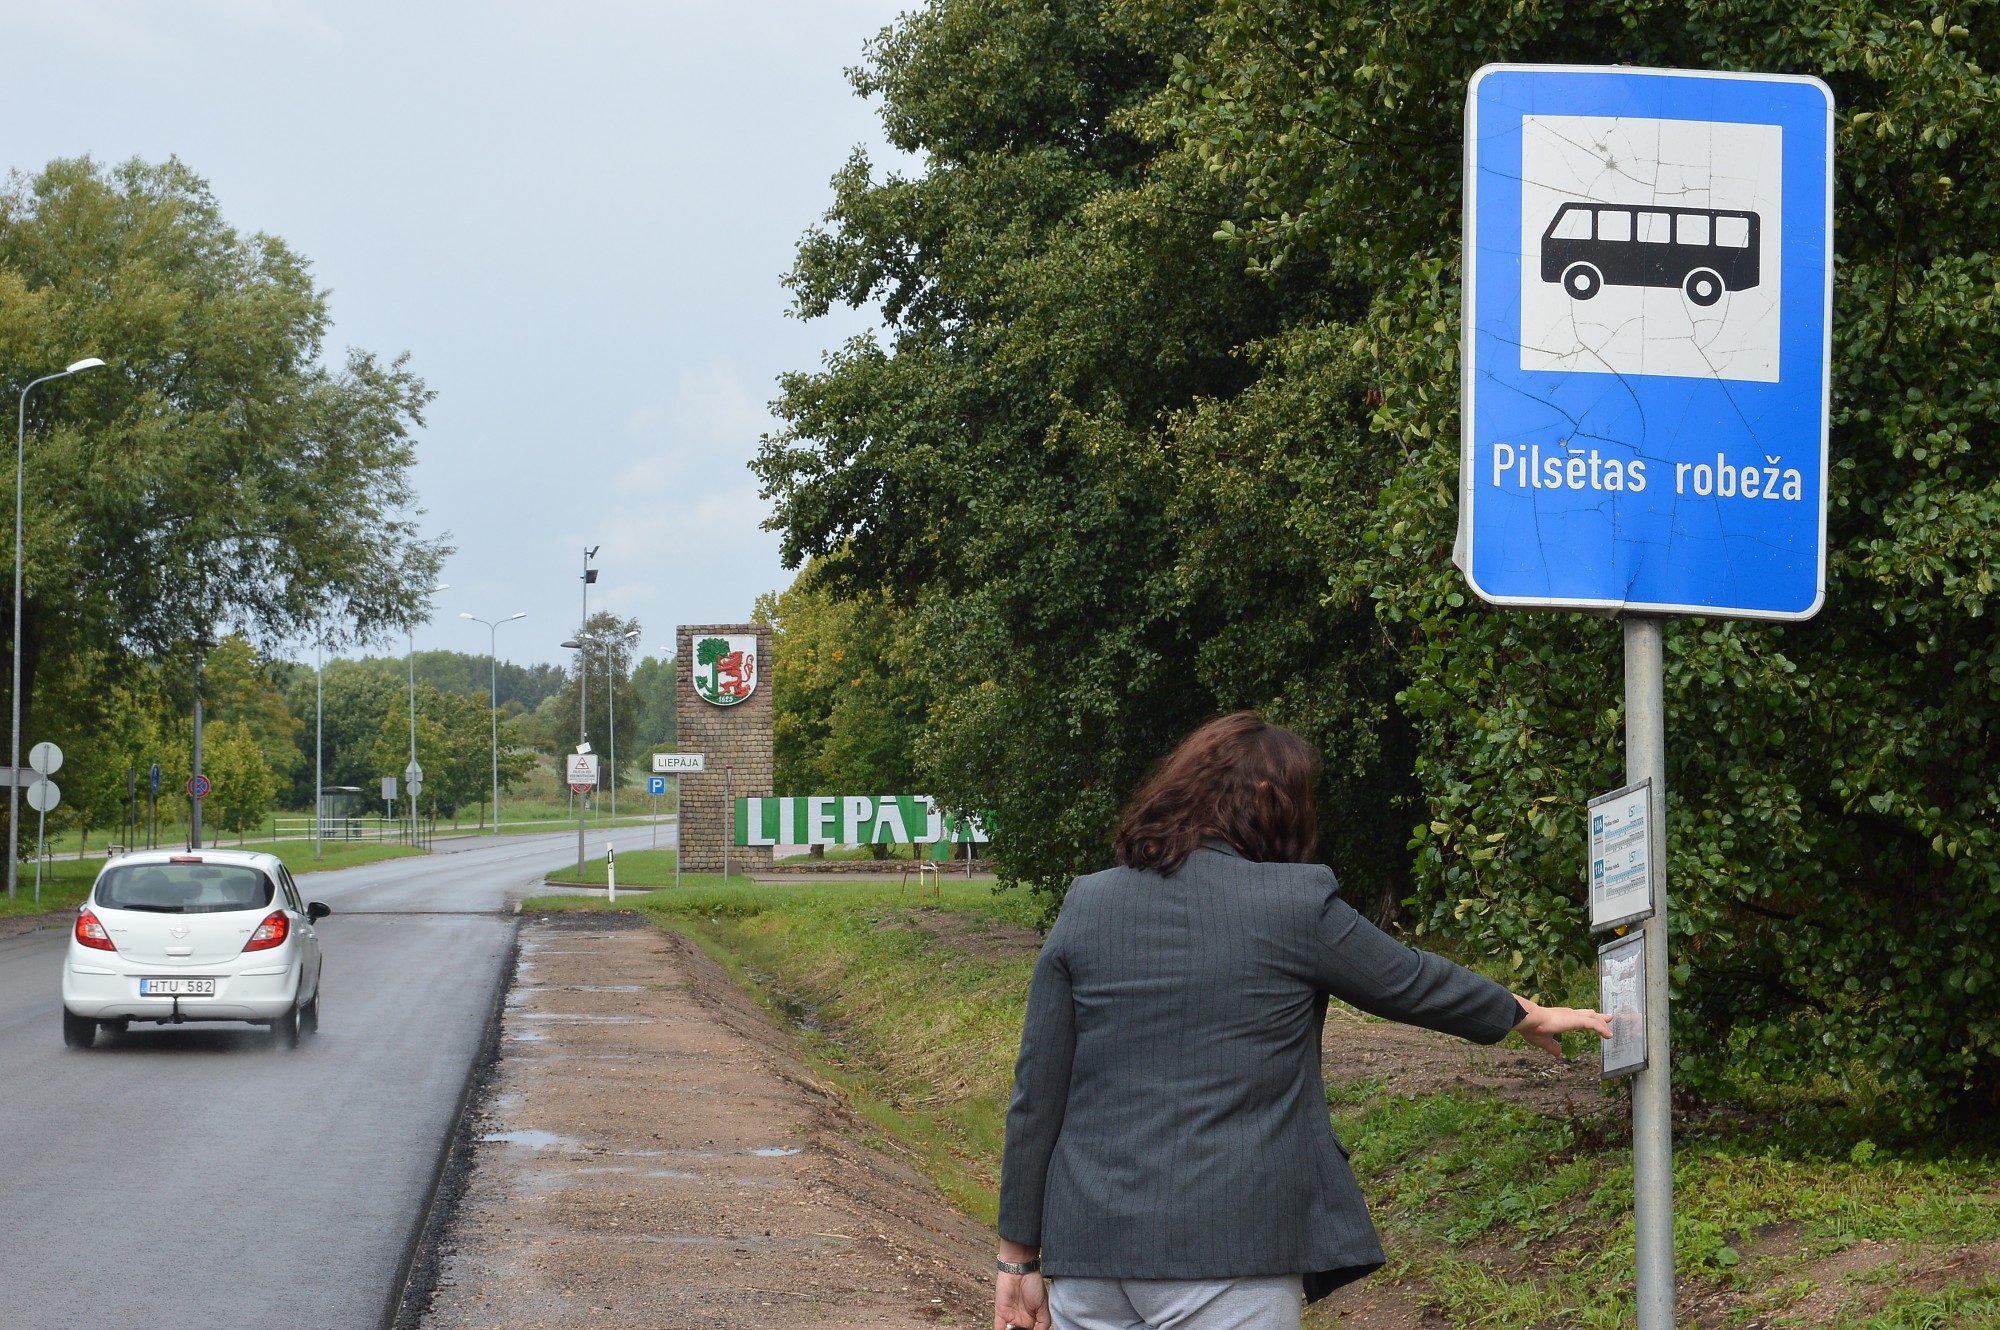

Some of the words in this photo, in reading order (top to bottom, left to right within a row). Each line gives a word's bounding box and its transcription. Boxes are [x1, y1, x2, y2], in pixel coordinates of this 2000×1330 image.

[1493, 443, 1647, 492] Pilsētas
[1676, 453, 1802, 501] robeža
[658, 757, 699, 767] LIEPĀJA
[652, 779, 663, 793] P
[149, 981, 178, 992] HTU
[187, 981, 212, 992] 582
